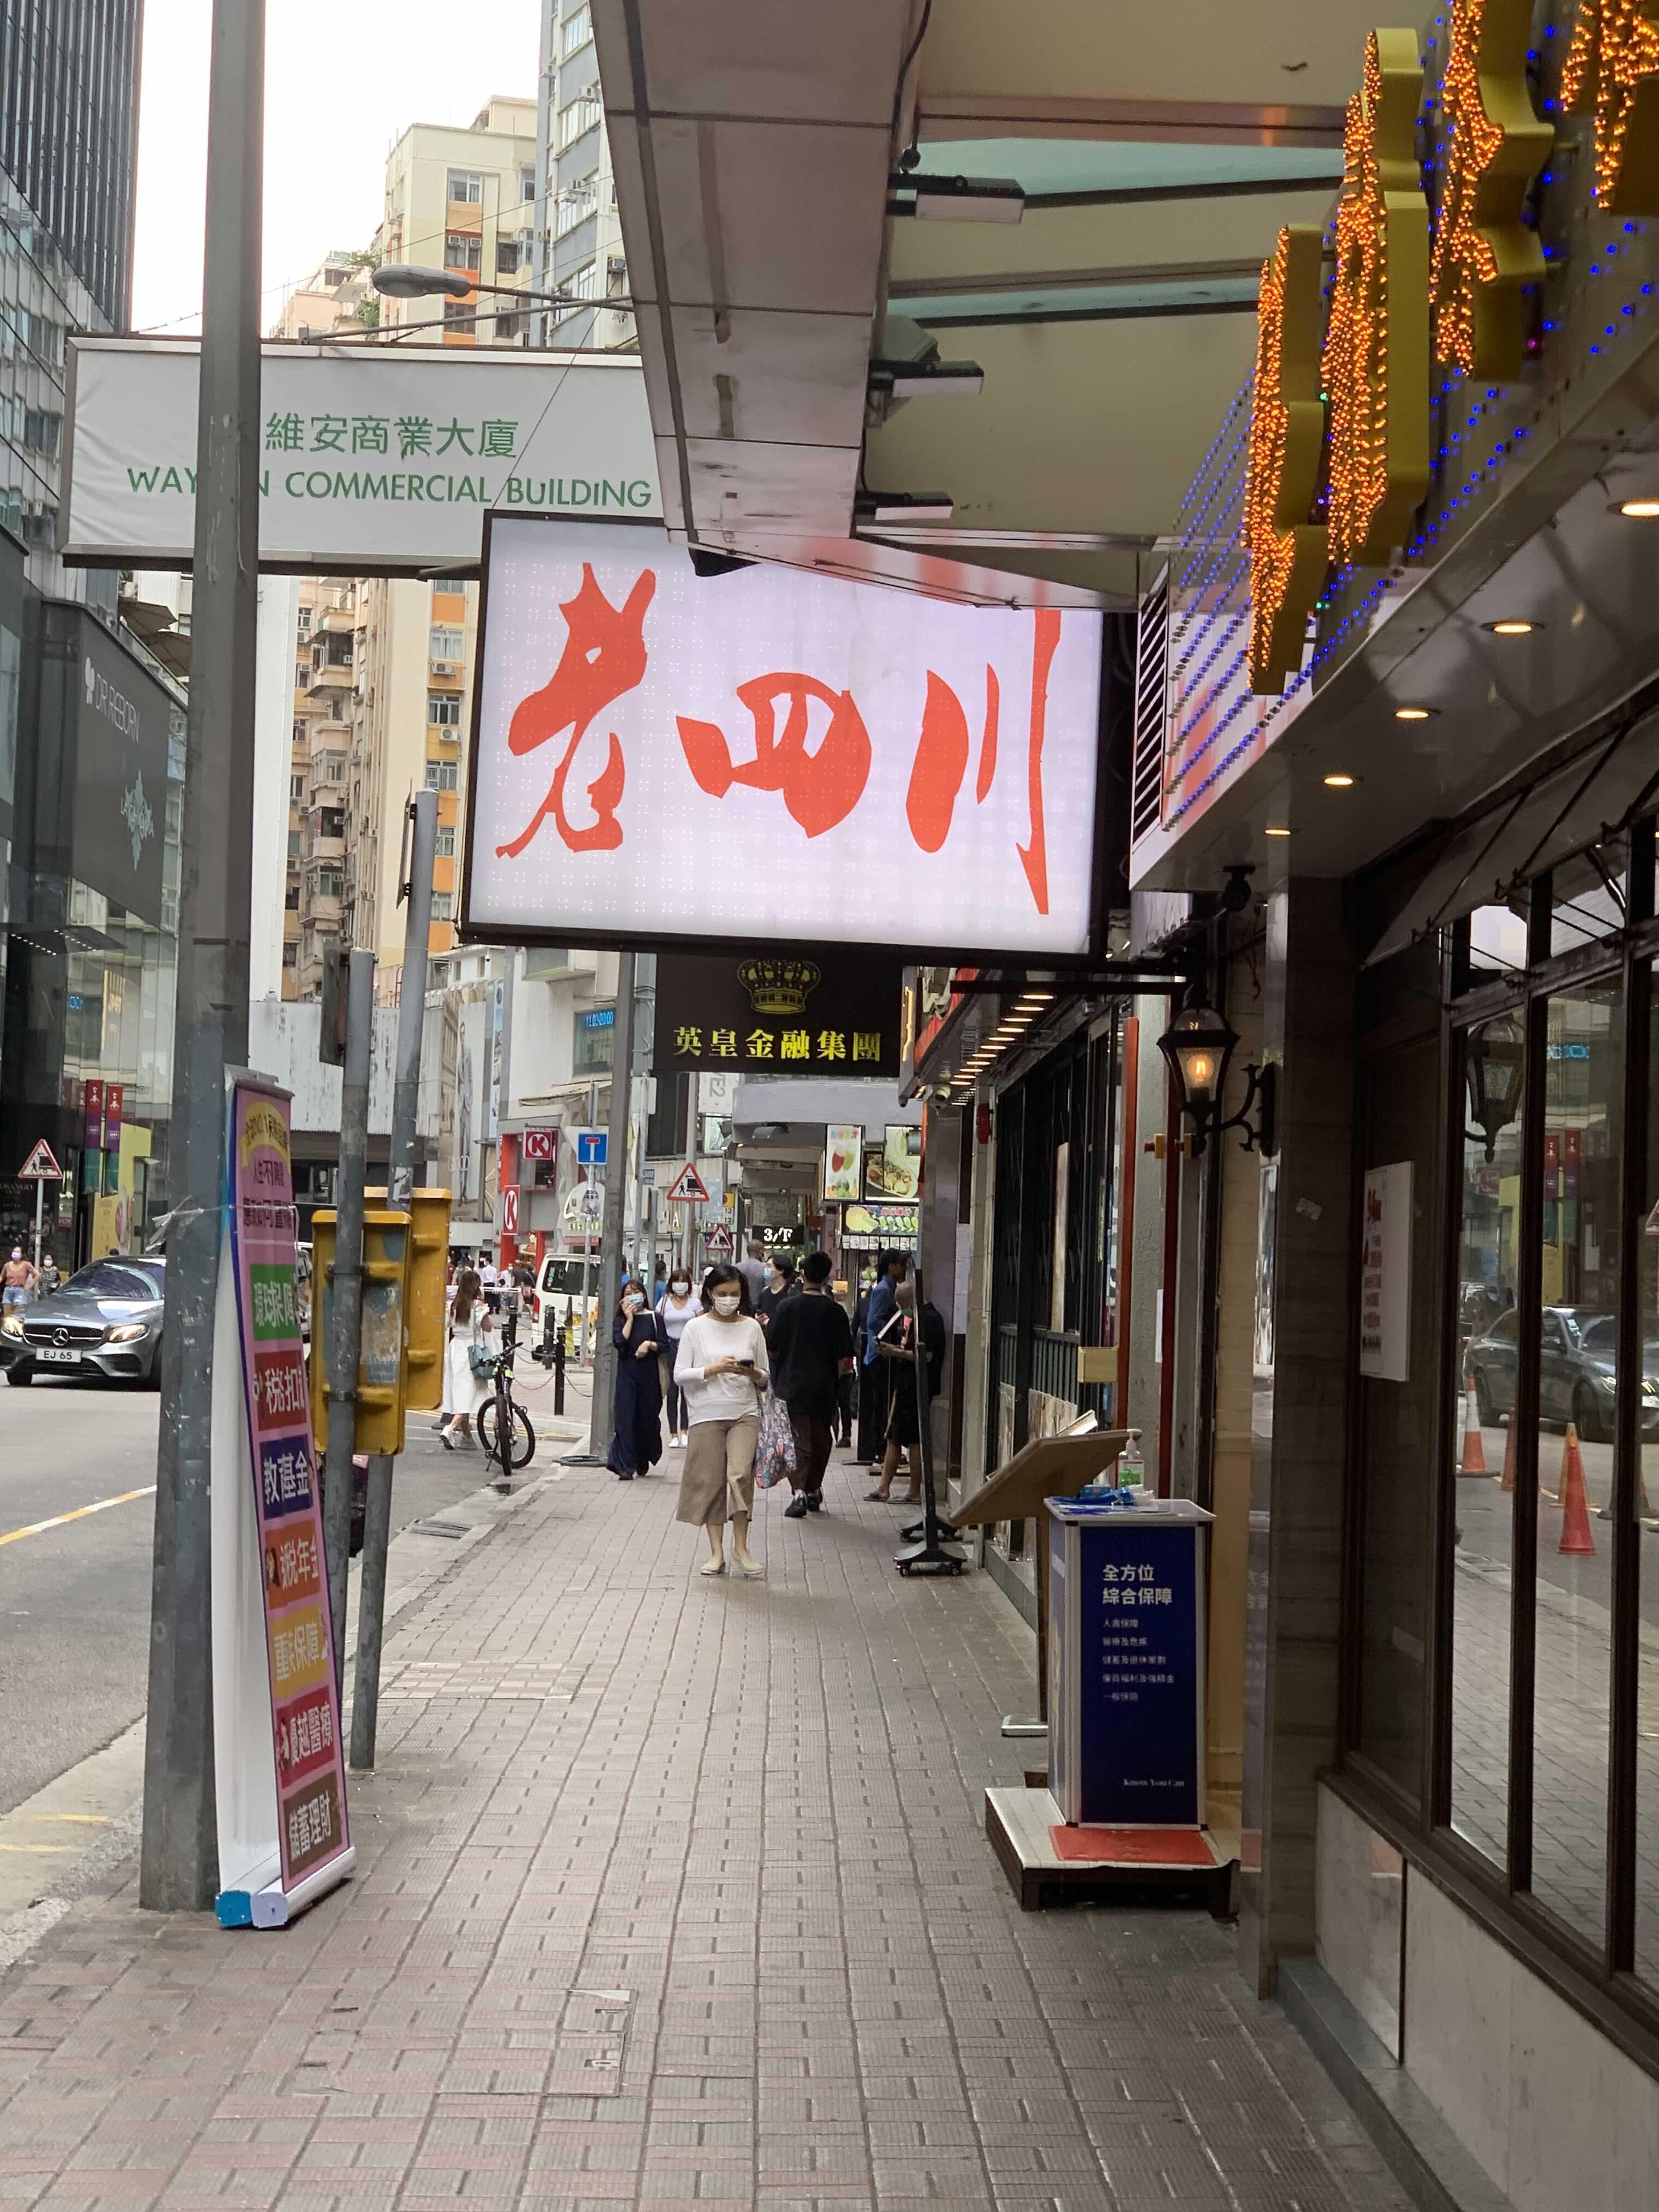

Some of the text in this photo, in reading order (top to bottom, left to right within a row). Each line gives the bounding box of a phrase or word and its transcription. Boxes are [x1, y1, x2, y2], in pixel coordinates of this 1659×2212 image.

[265, 412, 518, 460] 維安商業大廈
[285, 471, 492, 503] COMMERCIAL
[506, 477, 652, 507] BUILDING
[495, 562, 1061, 915] 老四川
[673, 1026, 881, 1062] 英皇金融集團
[763, 1227, 793, 1243] 3/F
[44, 1351, 72, 1360] EJ 65
[1103, 1564, 1154, 1582] 全方位
[1102, 1587, 1172, 1605] 綜合保障
